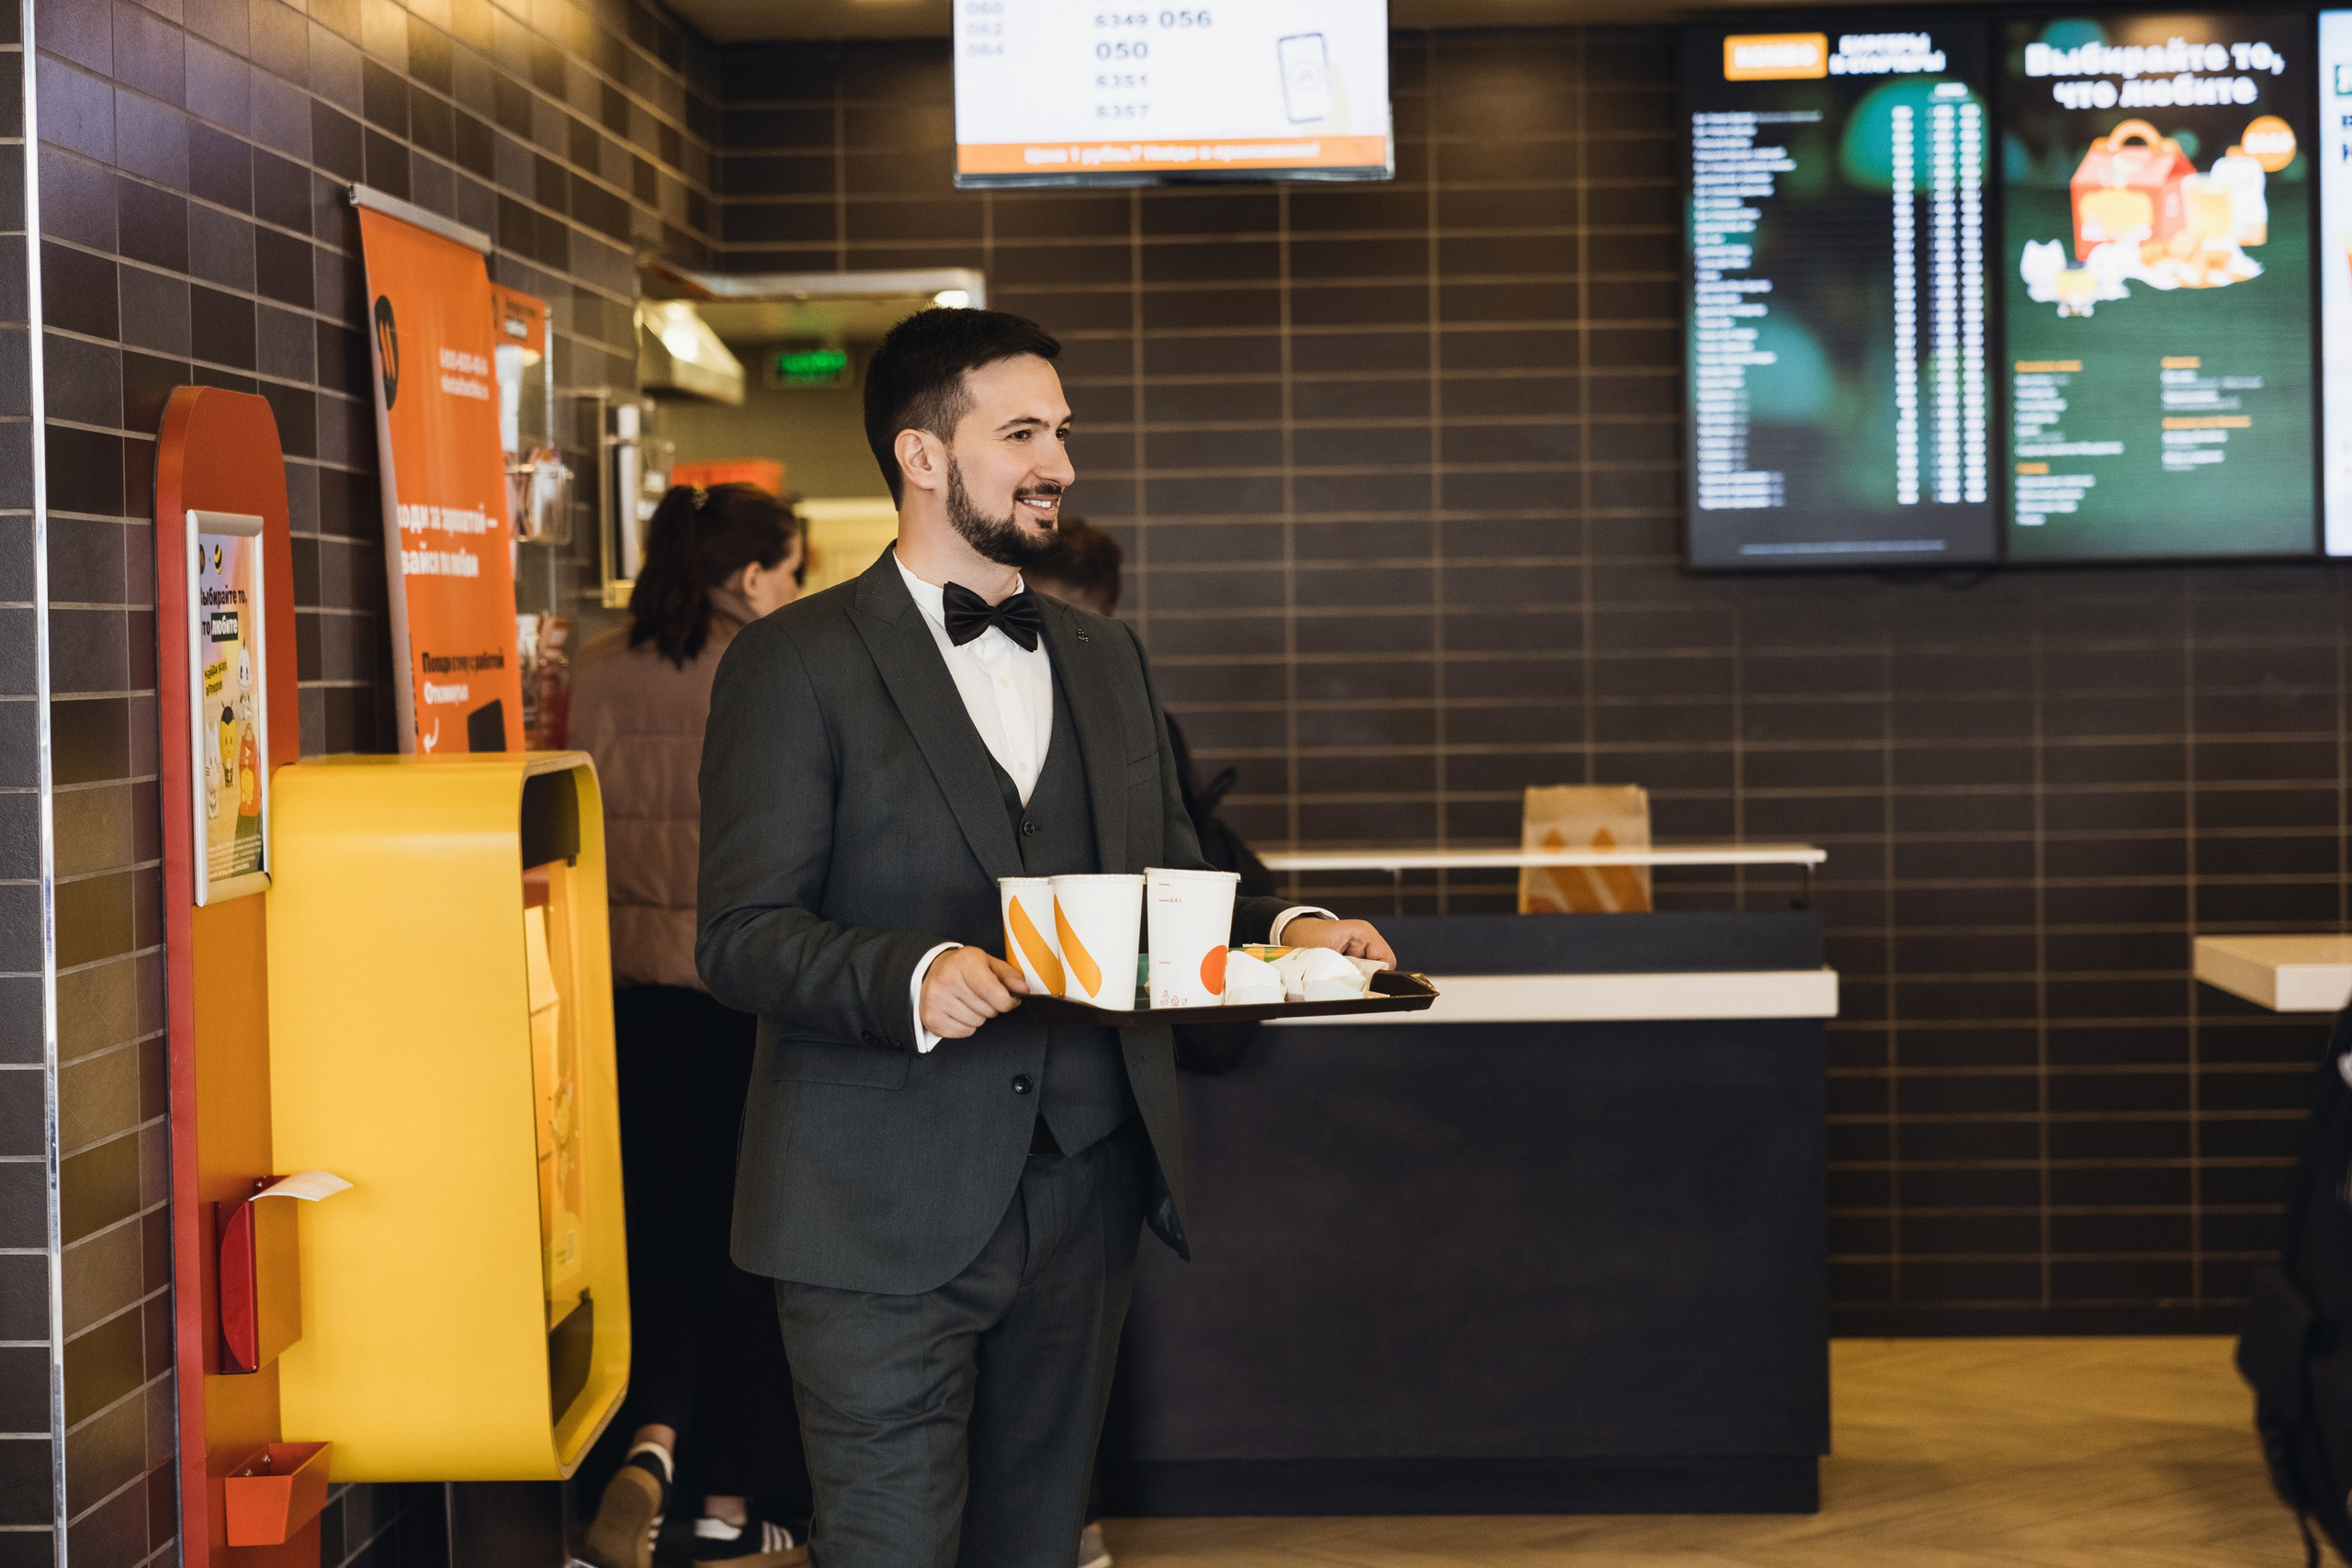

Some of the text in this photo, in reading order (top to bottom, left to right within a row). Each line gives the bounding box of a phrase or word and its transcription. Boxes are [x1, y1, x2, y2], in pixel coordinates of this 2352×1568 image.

[1159, 11, 1212, 28] 056
[1096, 42, 1148, 59] 050
[2025, 37, 2285, 79] Выбирайте то,
[2052, 72, 2258, 109] что любите
[211, 615, 238, 635] любите
